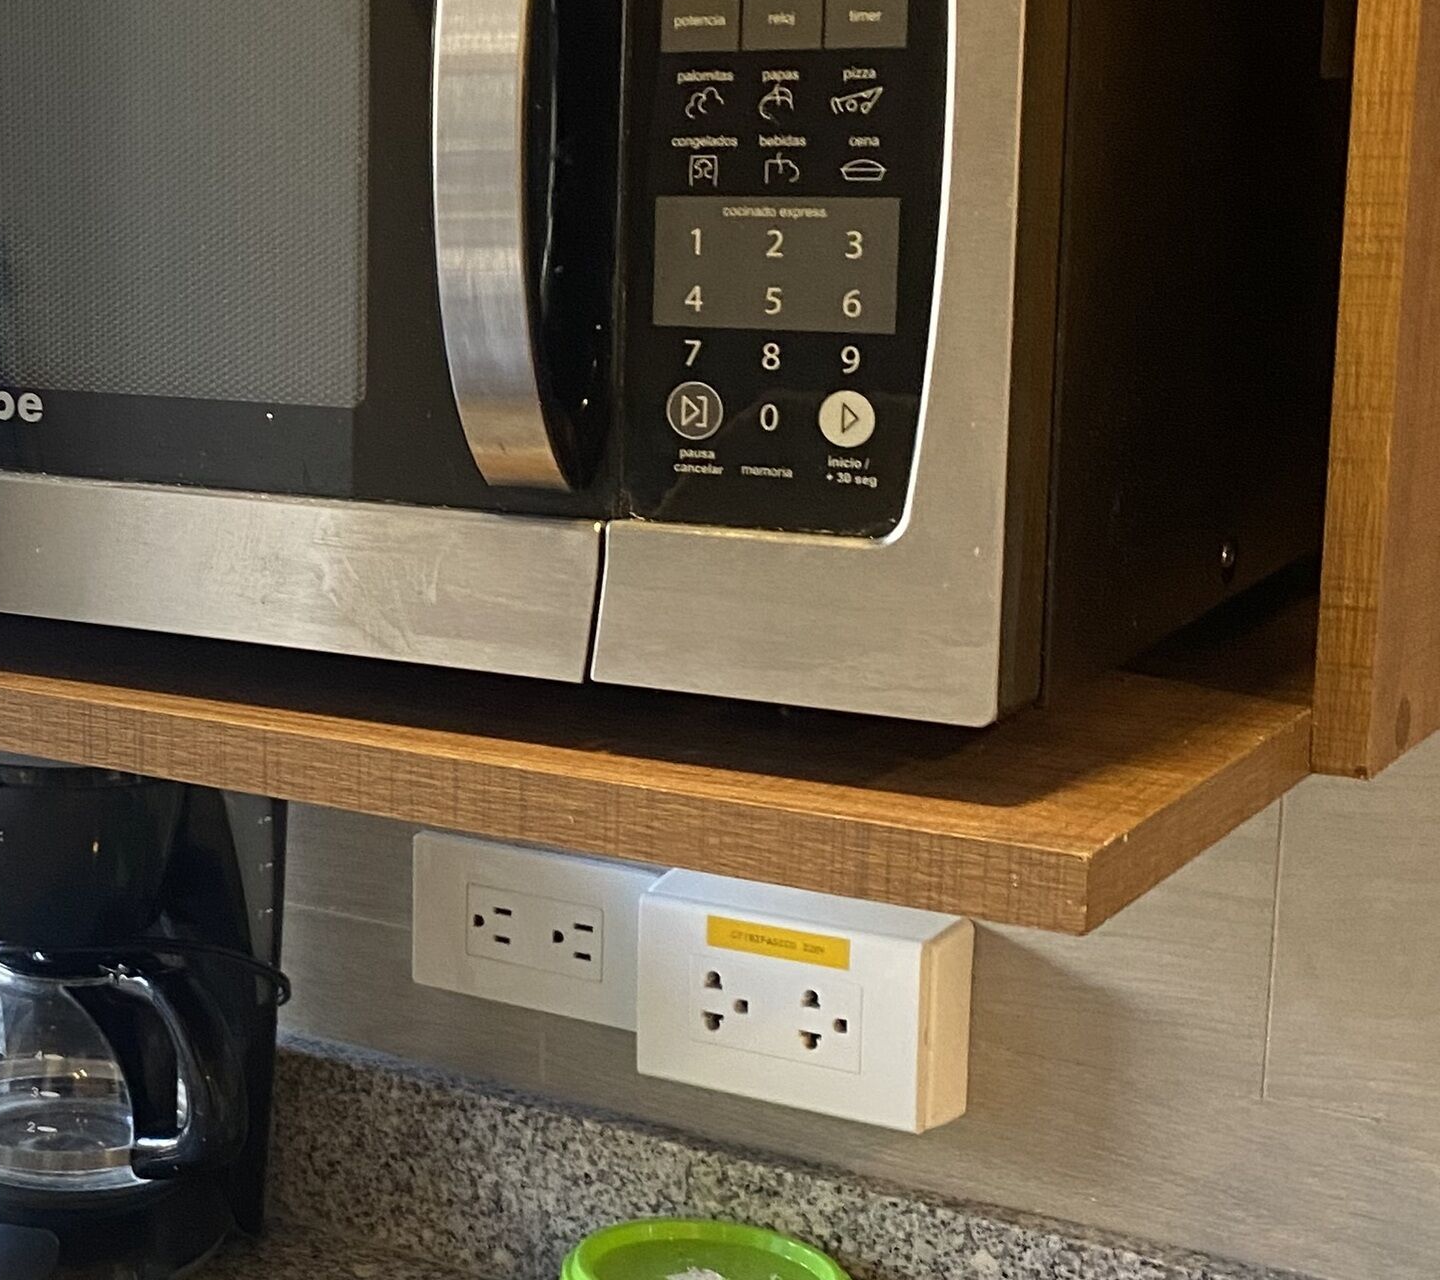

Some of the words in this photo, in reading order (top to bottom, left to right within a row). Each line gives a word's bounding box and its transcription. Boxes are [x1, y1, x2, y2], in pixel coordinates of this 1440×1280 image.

[674, 15, 726, 30] potencia
[677, 69, 735, 85] palomitas
[762, 70, 800, 83] papas
[843, 66, 877, 83] pizza
[671, 135, 738, 150] congelados
[759, 134, 807, 148] bebidas
[690, 228, 702, 255] 1
[766, 229, 784, 258] 2
[845, 231, 863, 260] 3
[684, 286, 703, 312] 4
[765, 287, 782, 315] 5
[842, 289, 862, 317] 6
[684, 340, 702, 367] 7
[762, 343, 781, 370] 8
[841, 346, 860, 374] 9
[759, 404, 779, 432] 0
[679, 447, 715, 460] pausa
[673, 462, 724, 475] cancelar
[827, 455, 862, 469] inicio
[741, 465, 793, 479] memoria
[836, 472, 852, 484] 30
[855, 474, 878, 488] seg
[35, 1050, 43, 1061] 4
[31, 1086, 39, 1098] 3
[27, 1121, 36, 1133] 2
